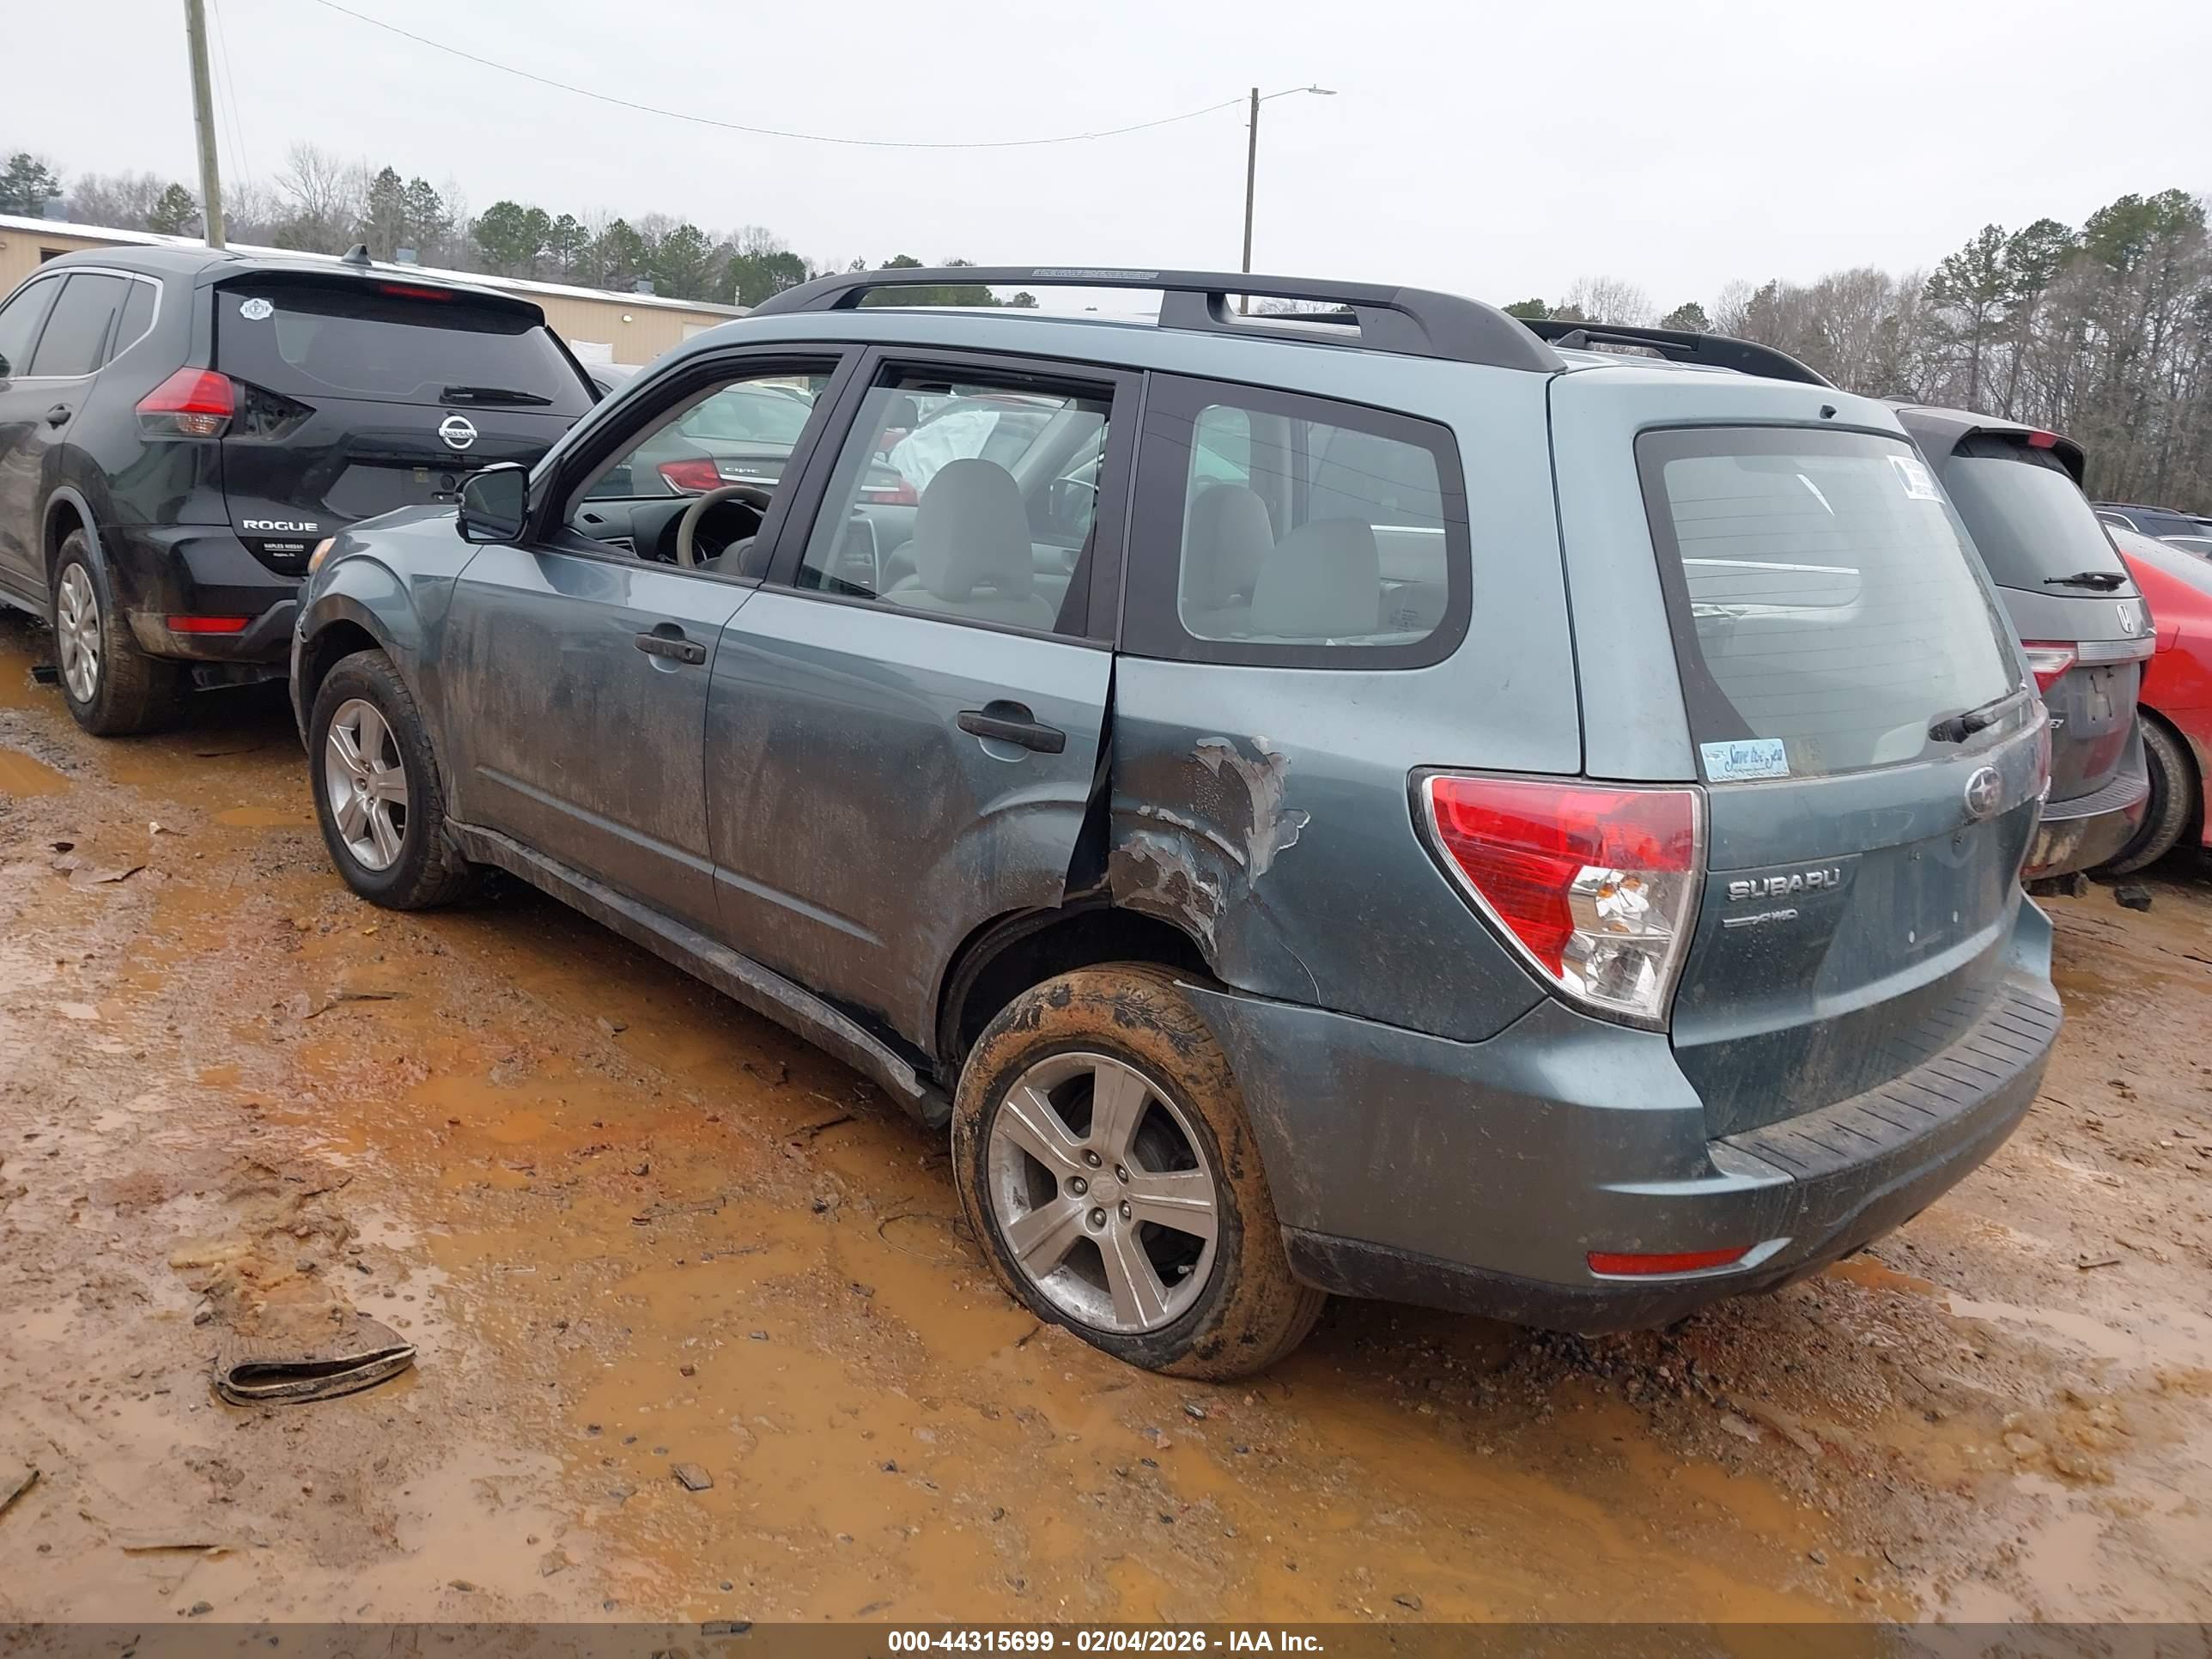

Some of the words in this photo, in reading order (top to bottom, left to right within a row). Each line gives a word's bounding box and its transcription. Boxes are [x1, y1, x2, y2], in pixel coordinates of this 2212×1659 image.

[444, 430, 475, 439] NISSAN
[242, 520, 318, 532] ROGUE
[1728, 868, 1841, 901] SUBARU
